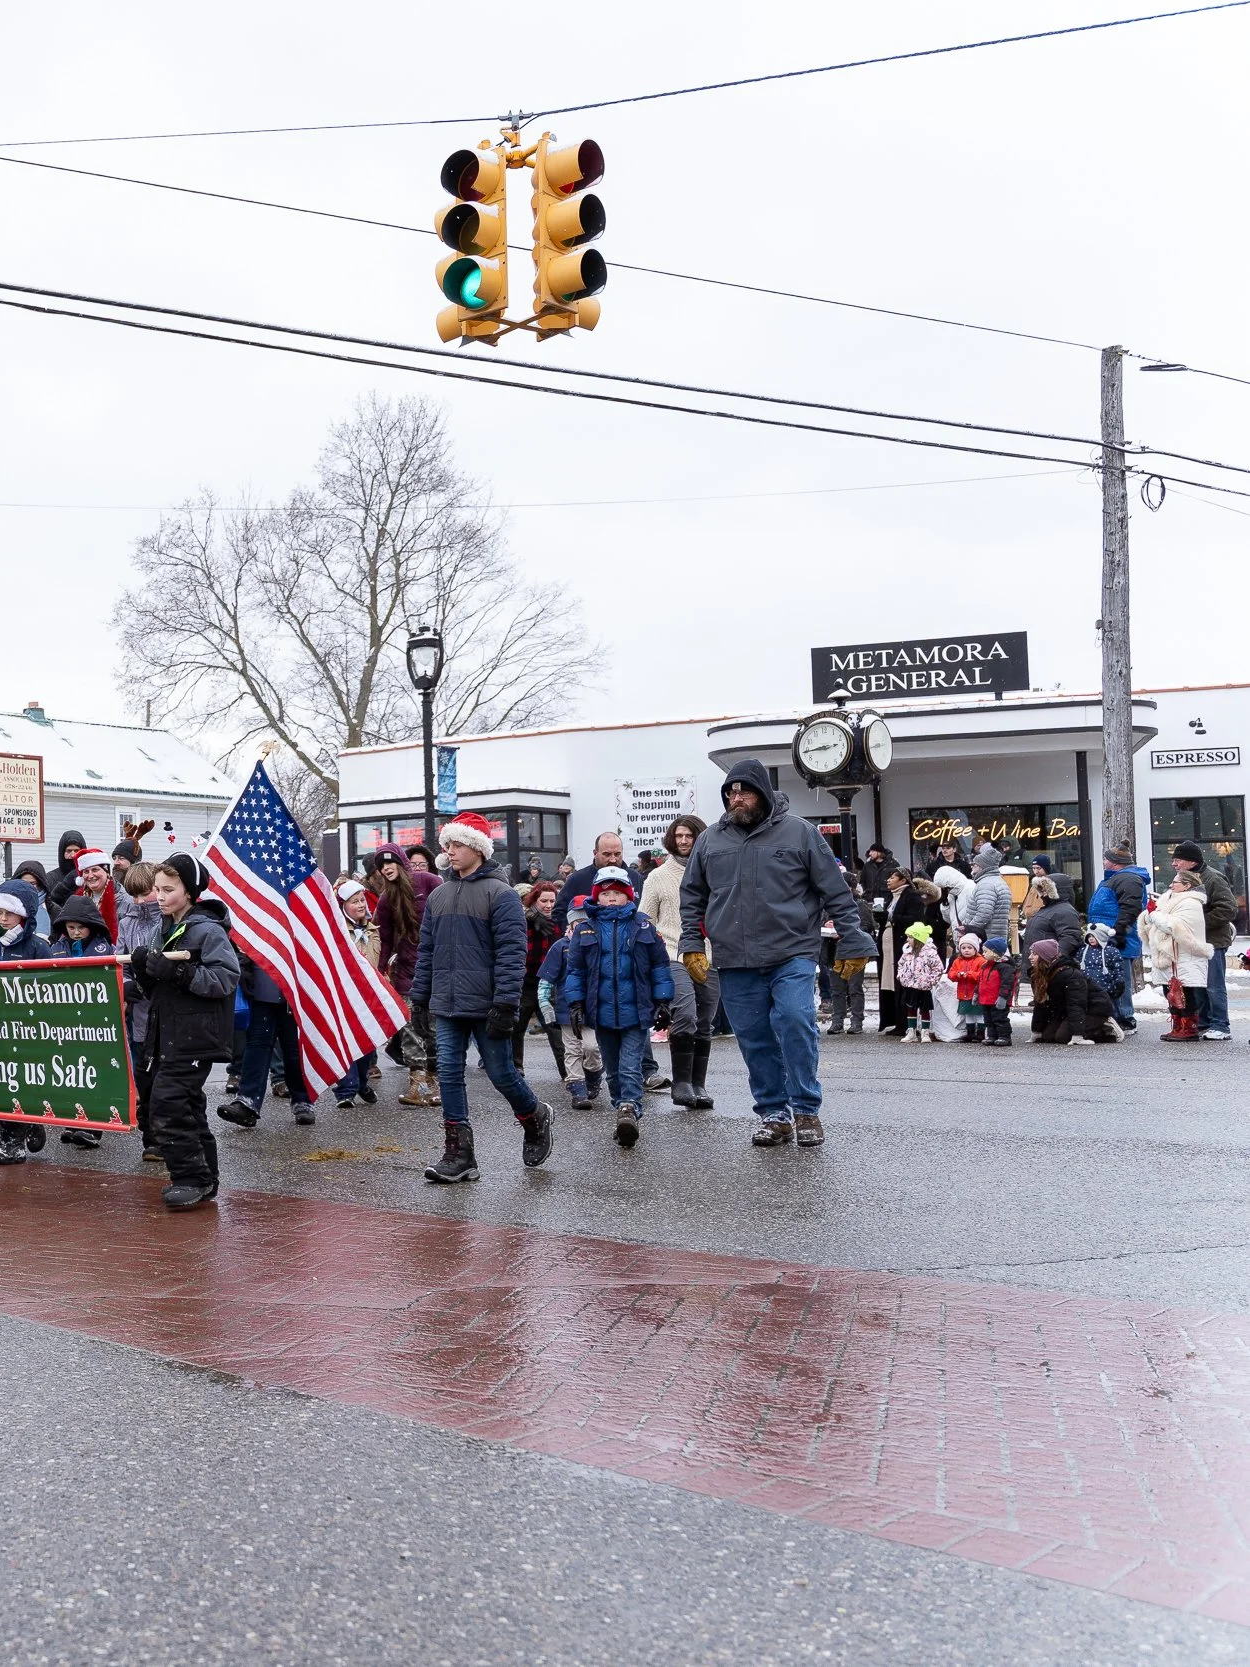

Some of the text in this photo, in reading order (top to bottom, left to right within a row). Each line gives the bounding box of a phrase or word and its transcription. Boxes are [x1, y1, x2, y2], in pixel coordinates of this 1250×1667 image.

[830, 641, 1009, 671] METAMORA
[847, 667, 992, 694] GENERAL
[1156, 751, 1235, 765] ESPRESSO
[632, 789, 677, 798] One stop
[632, 800, 681, 810] shopping
[4, 808, 38, 817] SPONSORED
[17, 817, 36, 826] RIDES
[626, 814, 639, 822] for
[27, 827, 35, 835] 20
[636, 826, 668, 834] on you
[913, 818, 1081, 845] Coffee + Wine Ba
[629, 837, 659, 846] "nice"
[0, 976, 109, 1004] Metamora
[11, 1021, 37, 1040] Fire
[40, 1022, 118, 1045] Department
[24, 1062, 46, 1086] us
[51, 1054, 97, 1090] Safe
